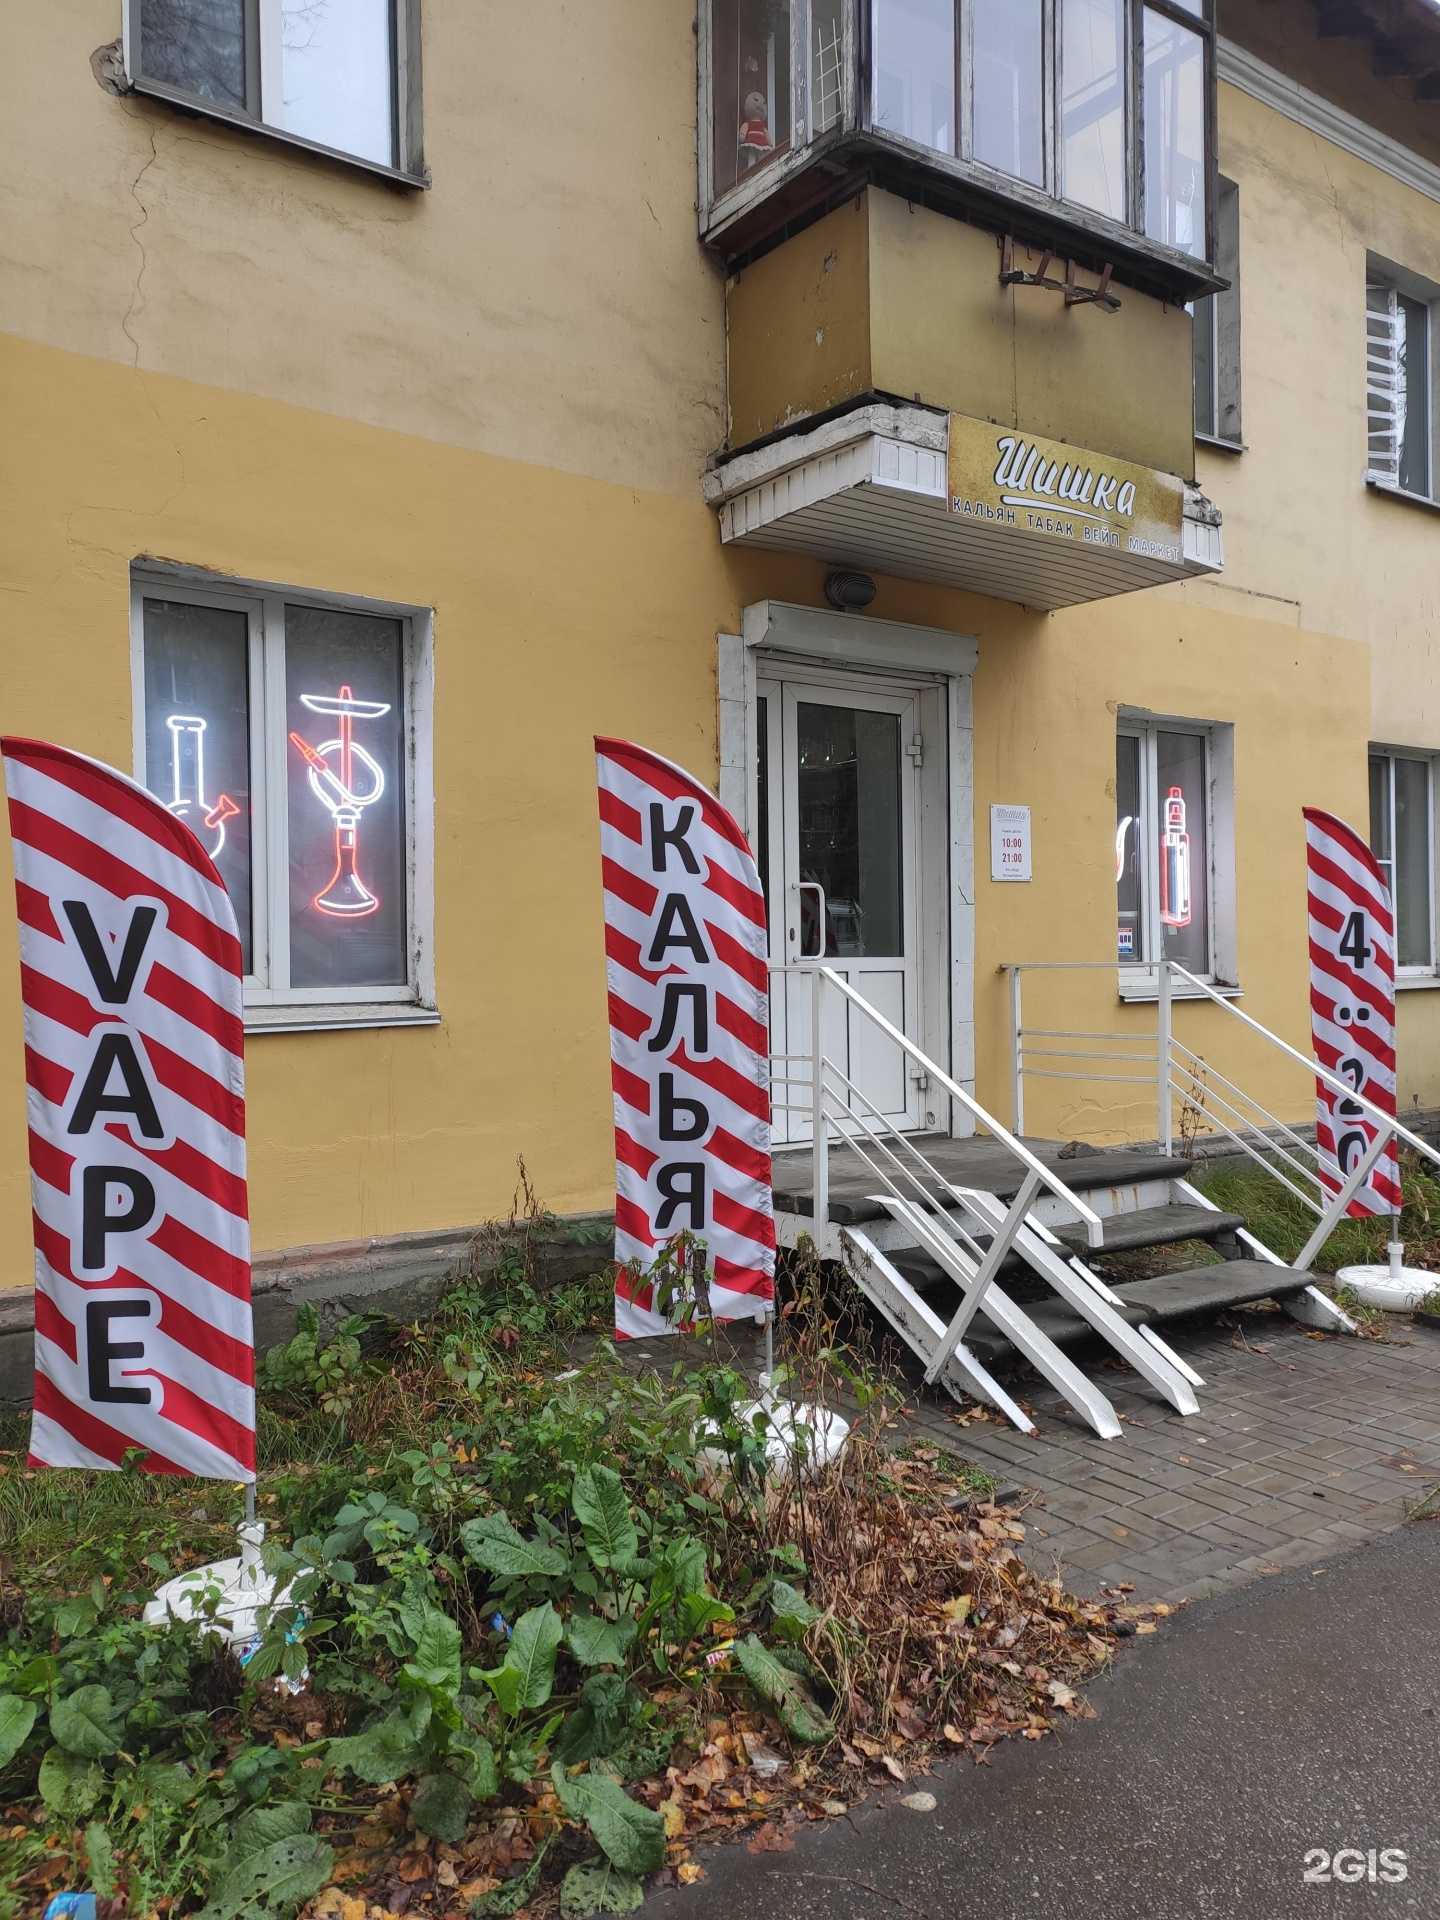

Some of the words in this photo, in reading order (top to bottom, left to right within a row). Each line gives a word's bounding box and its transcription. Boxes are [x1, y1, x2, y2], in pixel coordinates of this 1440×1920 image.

[994, 436, 1137, 516] Шишка
[952, 496, 1017, 525] КАЛЬЯН
[1027, 512, 1074, 538] ТАБАК
[1083, 526, 1121, 548] ВЕЙП
[1128, 535, 1180, 562] МАРКЕТ
[1002, 838, 1022, 848] 10:00
[1002, 852, 1023, 863] 21:00
[62, 900, 164, 1405] VAPE
